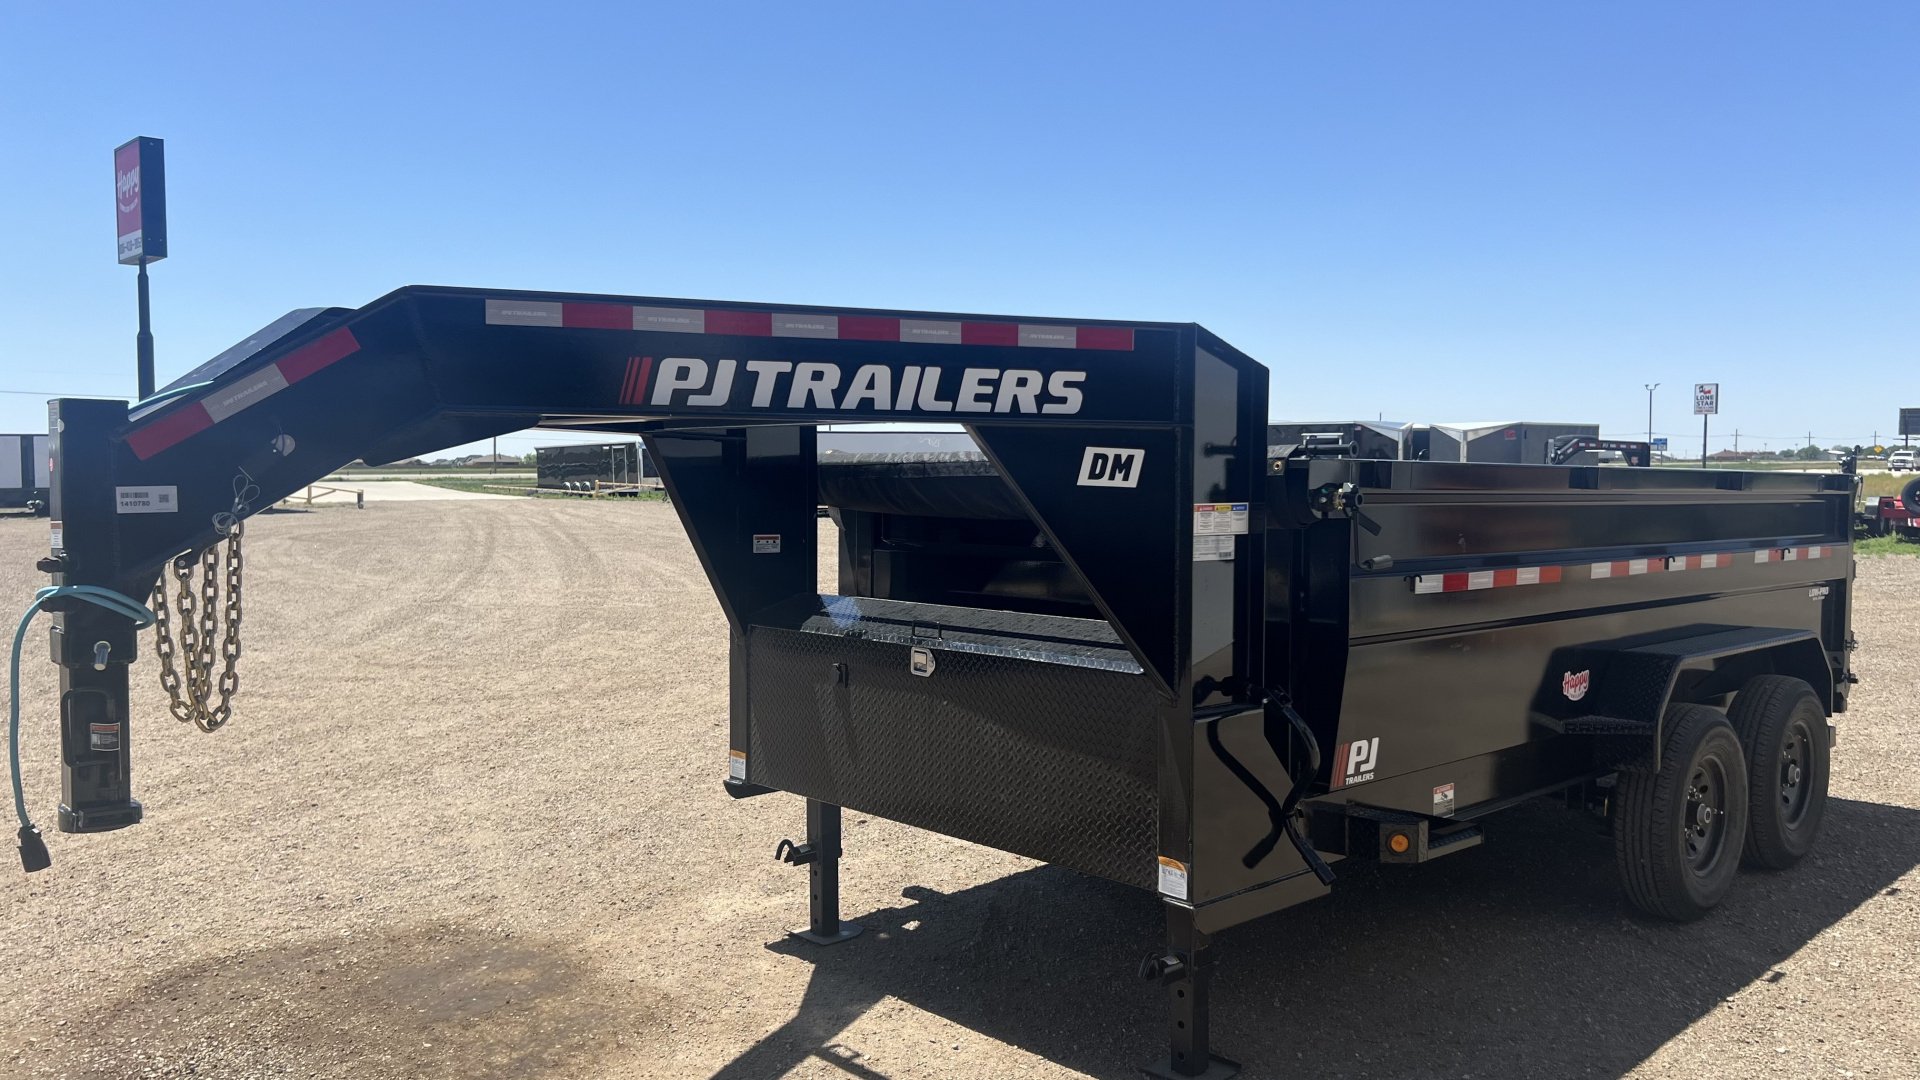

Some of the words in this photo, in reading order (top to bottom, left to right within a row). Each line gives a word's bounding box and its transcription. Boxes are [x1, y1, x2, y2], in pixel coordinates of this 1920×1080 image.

[117, 166, 139, 200] Happy
[651, 357, 737, 407] PJ
[745, 361, 1087, 414] TRAILERS
[1087, 452, 1136, 483] DM
[1563, 670, 1589, 694] Happy
[1346, 737, 1380, 775] PJ
[1345, 772, 1375, 785] TRAILERS
